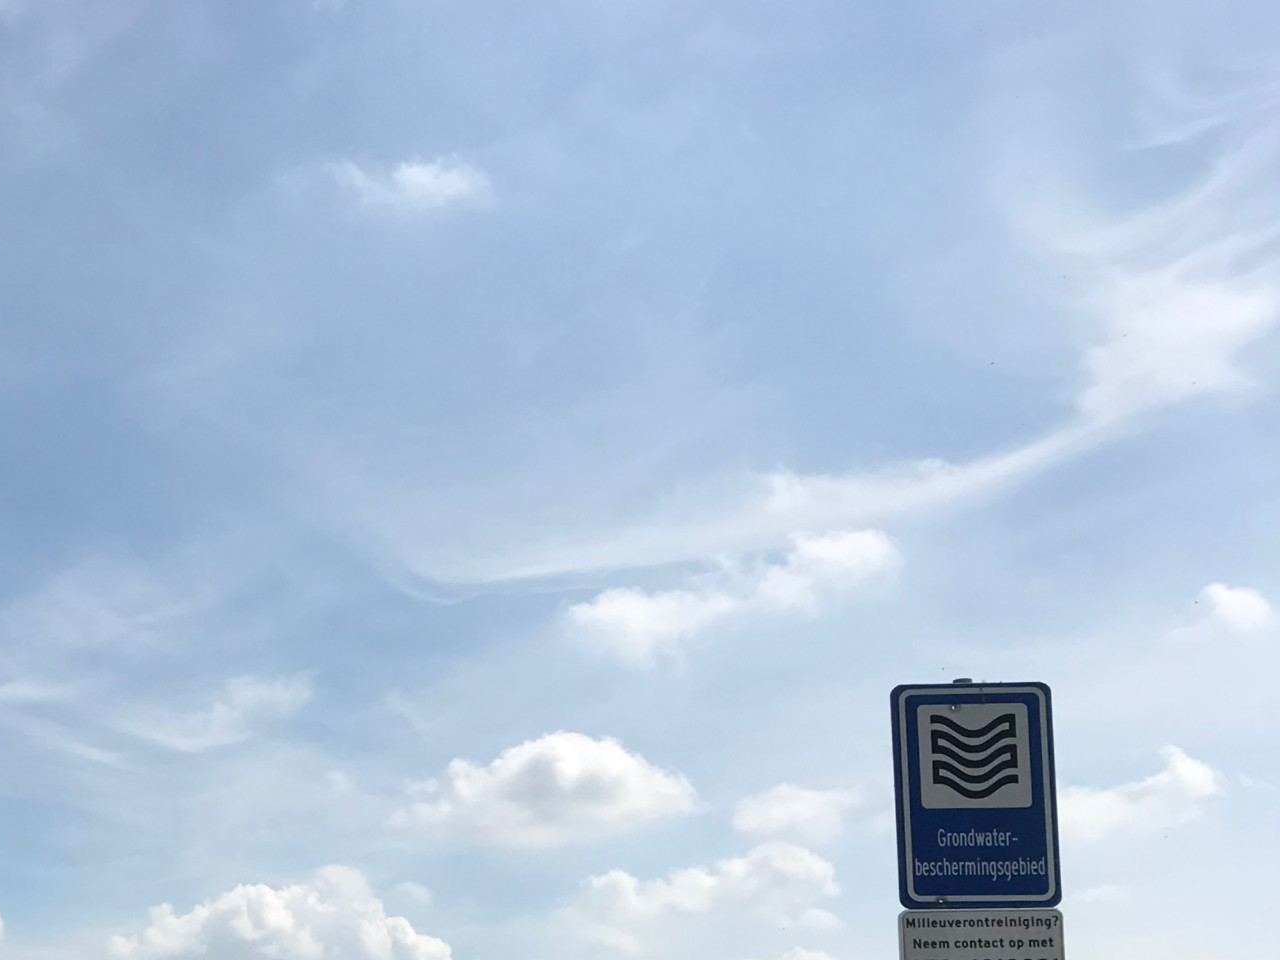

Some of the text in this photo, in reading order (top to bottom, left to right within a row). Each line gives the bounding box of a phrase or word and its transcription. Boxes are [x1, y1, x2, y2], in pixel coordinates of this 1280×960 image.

[937, 828, 1019, 847] Grondwater-
[915, 857, 1046, 881] beschermingsgebied
[906, 915, 1059, 930] Milieuverontreiniging?
[913, 937, 1054, 950] Neem contact op met
